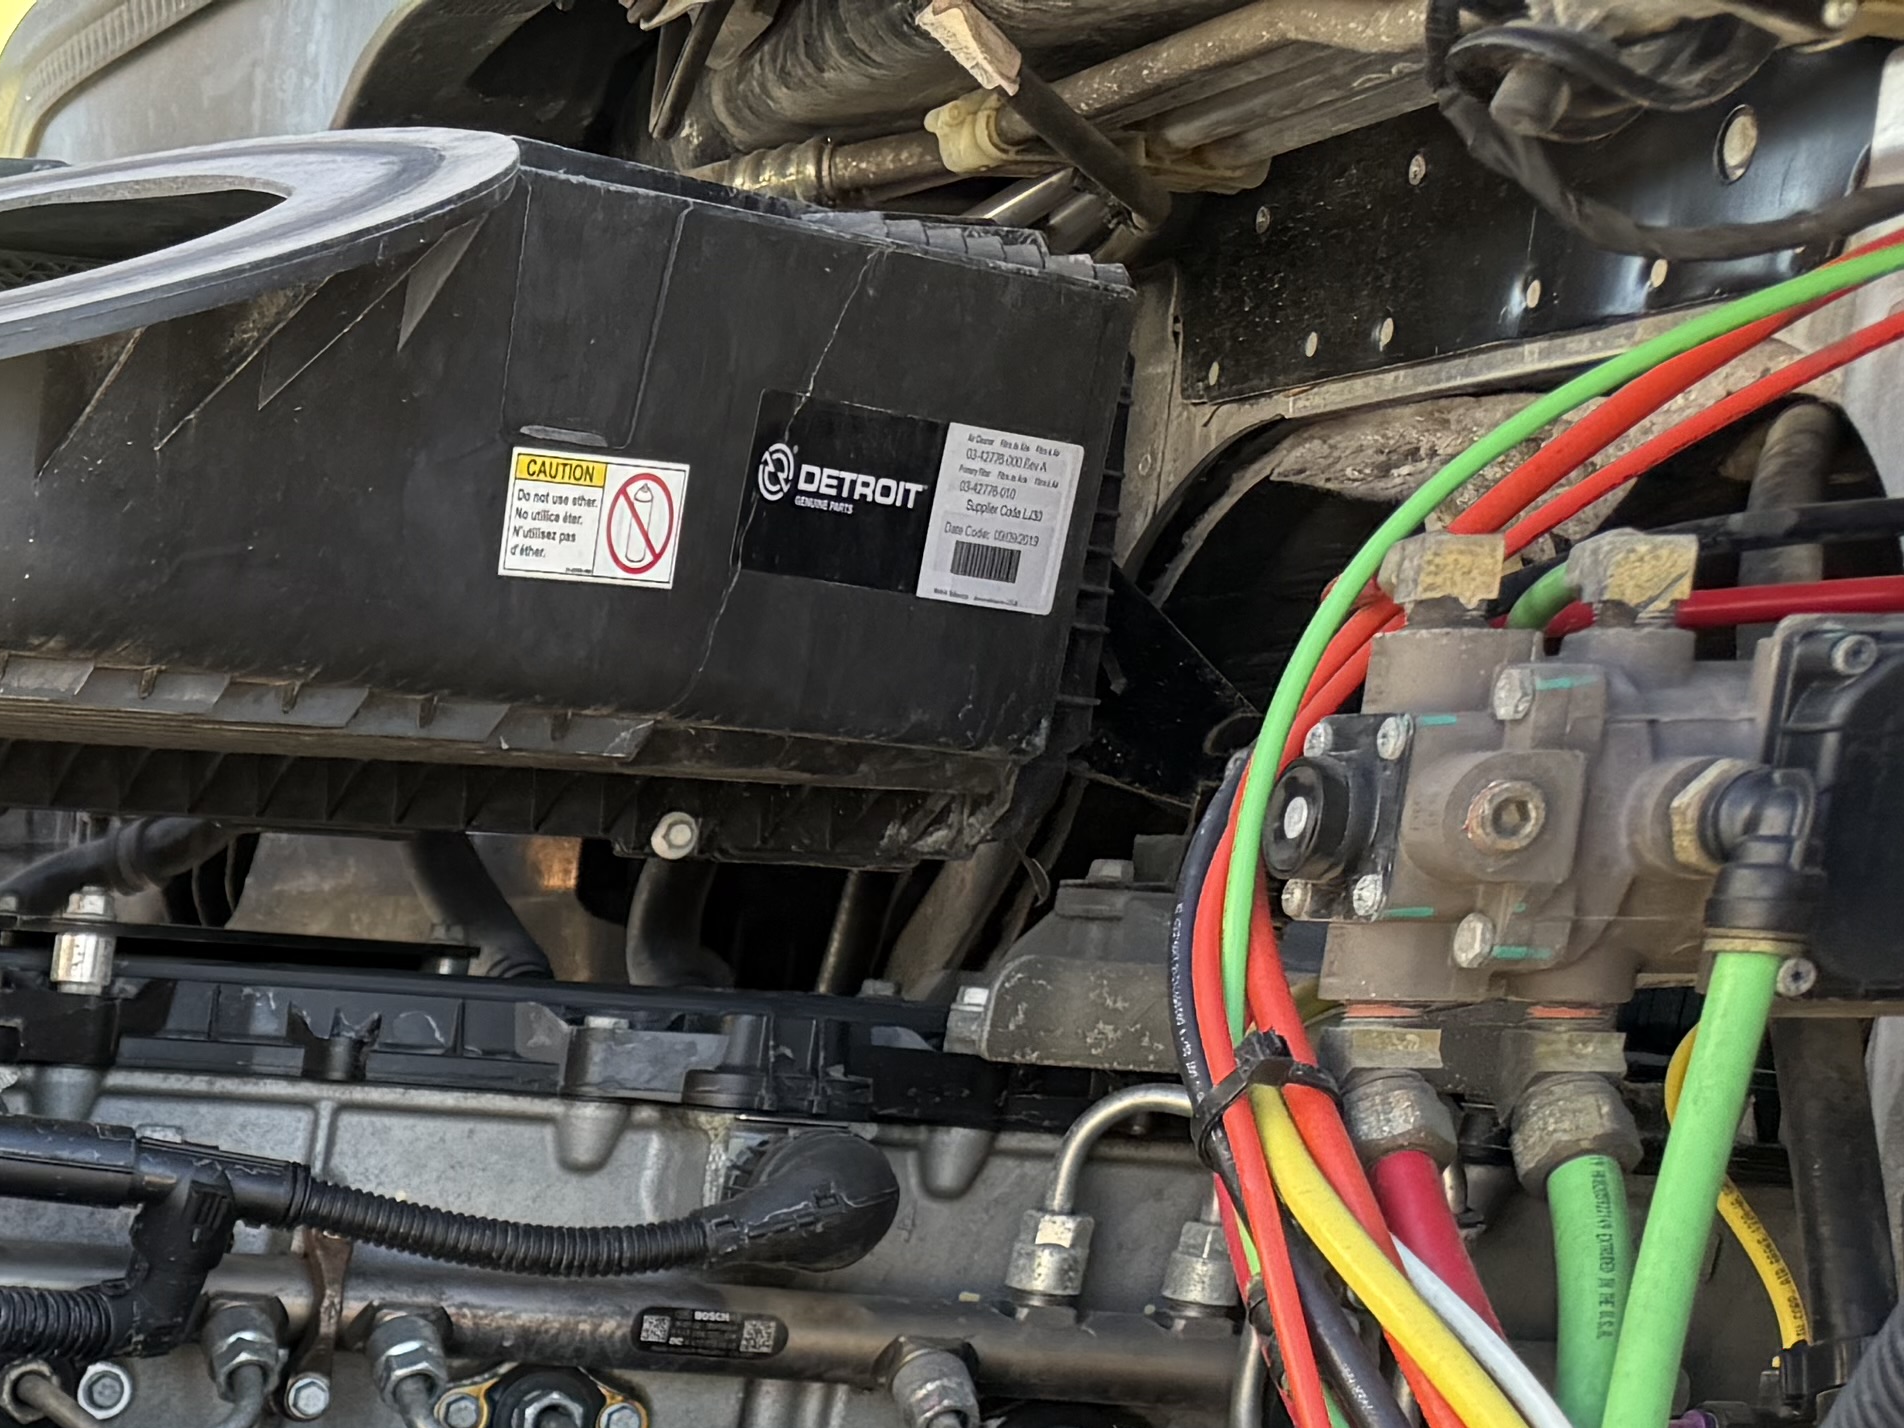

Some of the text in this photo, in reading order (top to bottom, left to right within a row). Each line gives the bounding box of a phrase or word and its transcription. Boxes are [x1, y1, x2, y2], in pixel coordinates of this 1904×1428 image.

[526, 459, 595, 483] CAUTION
[798, 464, 923, 509] DETROIT
[517, 488, 531, 502] Do
[533, 490, 550, 503] not
[552, 494, 570, 506] use
[794, 495, 854, 515] GENUINE PARTS
[515, 508, 529, 520] No
[559, 532, 576, 544] pas
[694, 1310, 730, 1322] BOSCH
